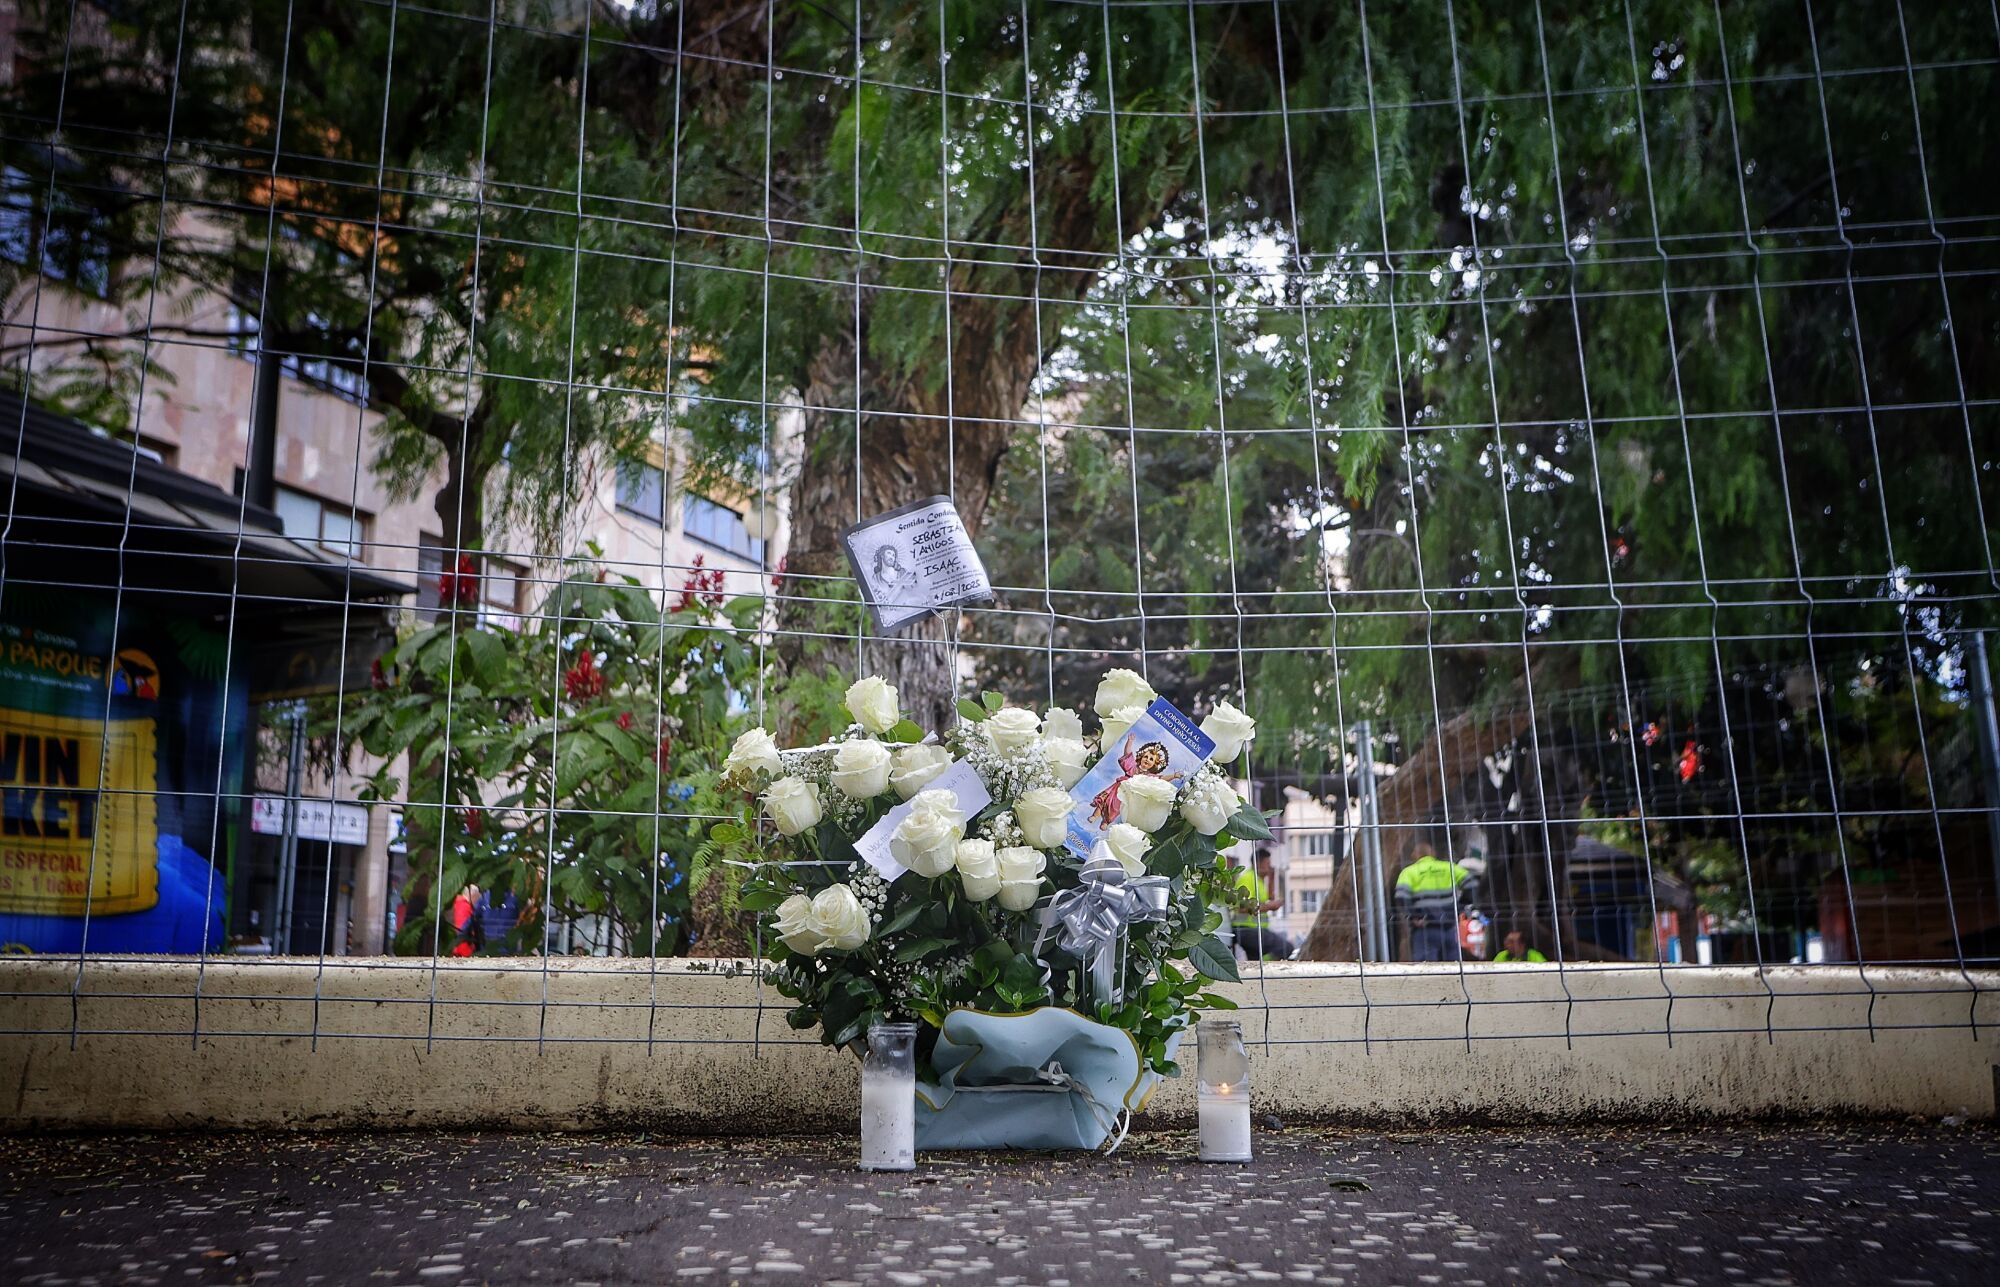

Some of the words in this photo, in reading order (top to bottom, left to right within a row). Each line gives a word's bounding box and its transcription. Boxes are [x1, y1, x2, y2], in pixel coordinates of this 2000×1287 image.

[896, 518, 925, 534] Sentida
[909, 548, 917, 559] Y
[919, 536, 955, 556] AMIGOS
[923, 556, 961, 578] ISAAC
[9, 640, 103, 680] PARQUE
[1154, 710, 1174, 728] DIVINO
[1171, 726, 1187, 740] NIÑO
[1185, 738, 1202, 753] JESÚS
[1164, 709, 1194, 737] CORONILLA
[1193, 734, 1201, 742] AL
[4, 848, 85, 873] ESPECIAL
